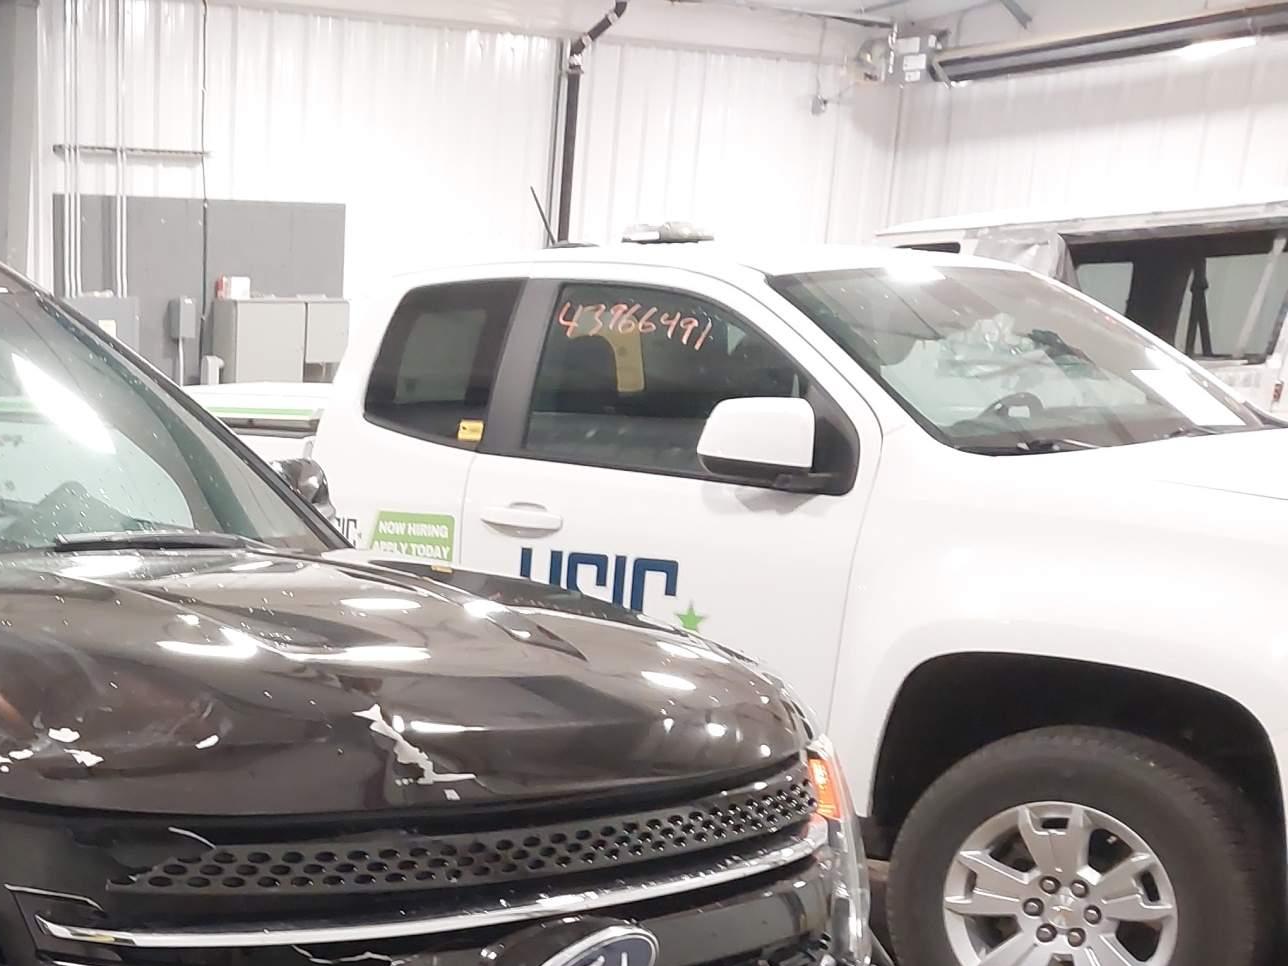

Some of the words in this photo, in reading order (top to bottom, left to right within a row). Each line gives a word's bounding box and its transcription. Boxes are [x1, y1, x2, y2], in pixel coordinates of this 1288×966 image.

[558, 301, 713, 351] 43966491
[378, 520, 406, 535] NOW
[407, 522, 449, 539] HIRING
[373, 540, 408, 554] APPLY
[409, 543, 451, 560] TODAY
